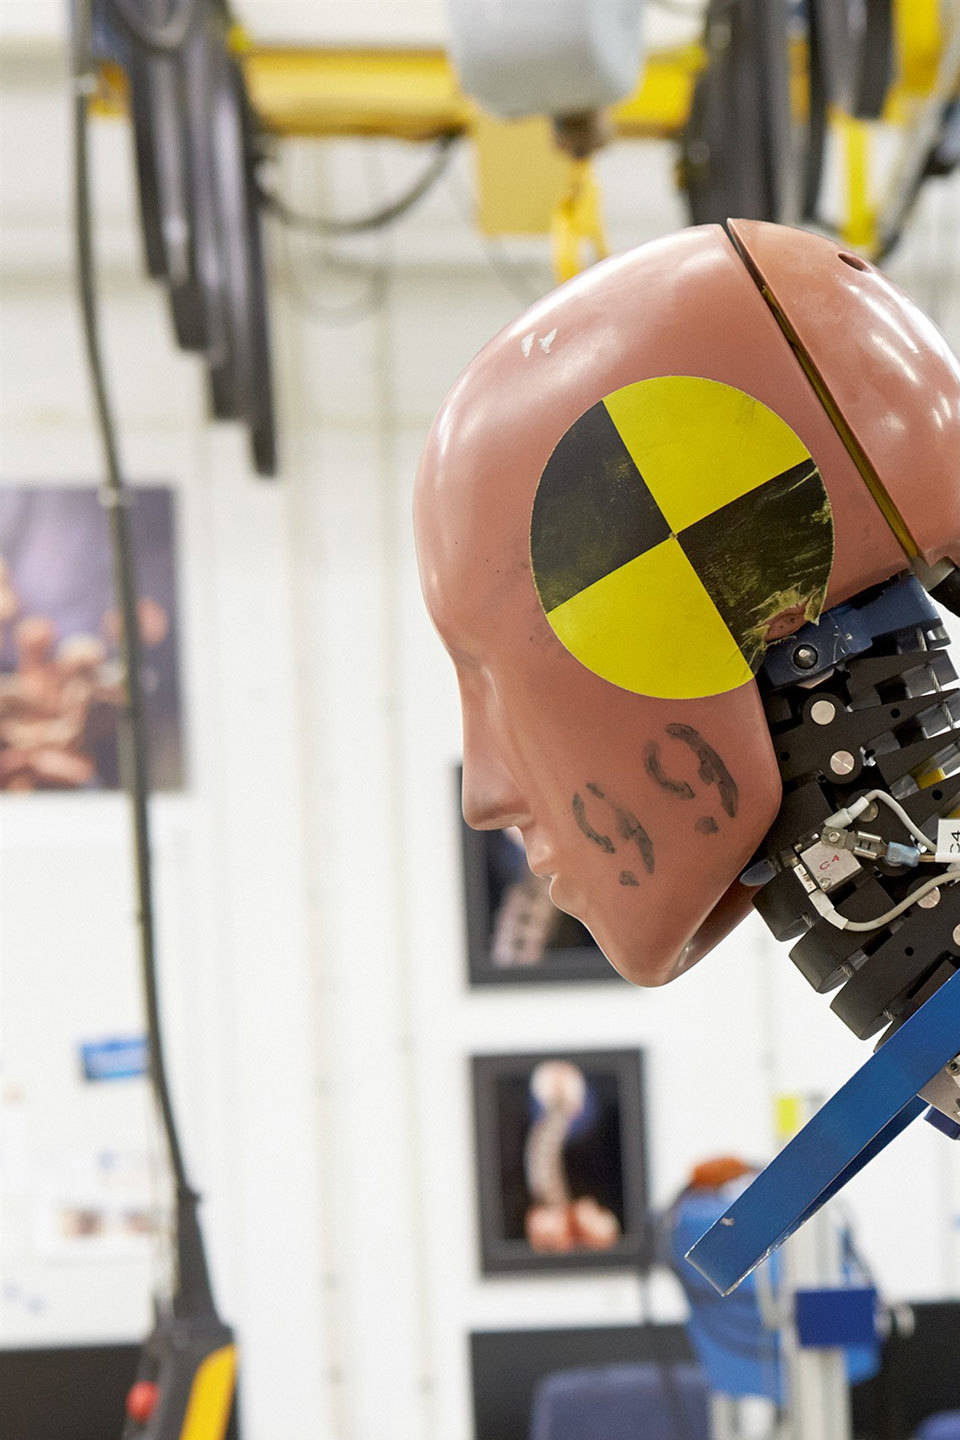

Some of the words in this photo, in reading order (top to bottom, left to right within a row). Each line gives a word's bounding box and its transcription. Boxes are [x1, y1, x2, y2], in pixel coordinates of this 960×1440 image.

[572, 723, 739, 887] 99
[949, 830, 960, 853] C4
[819, 854, 840, 870] C4
